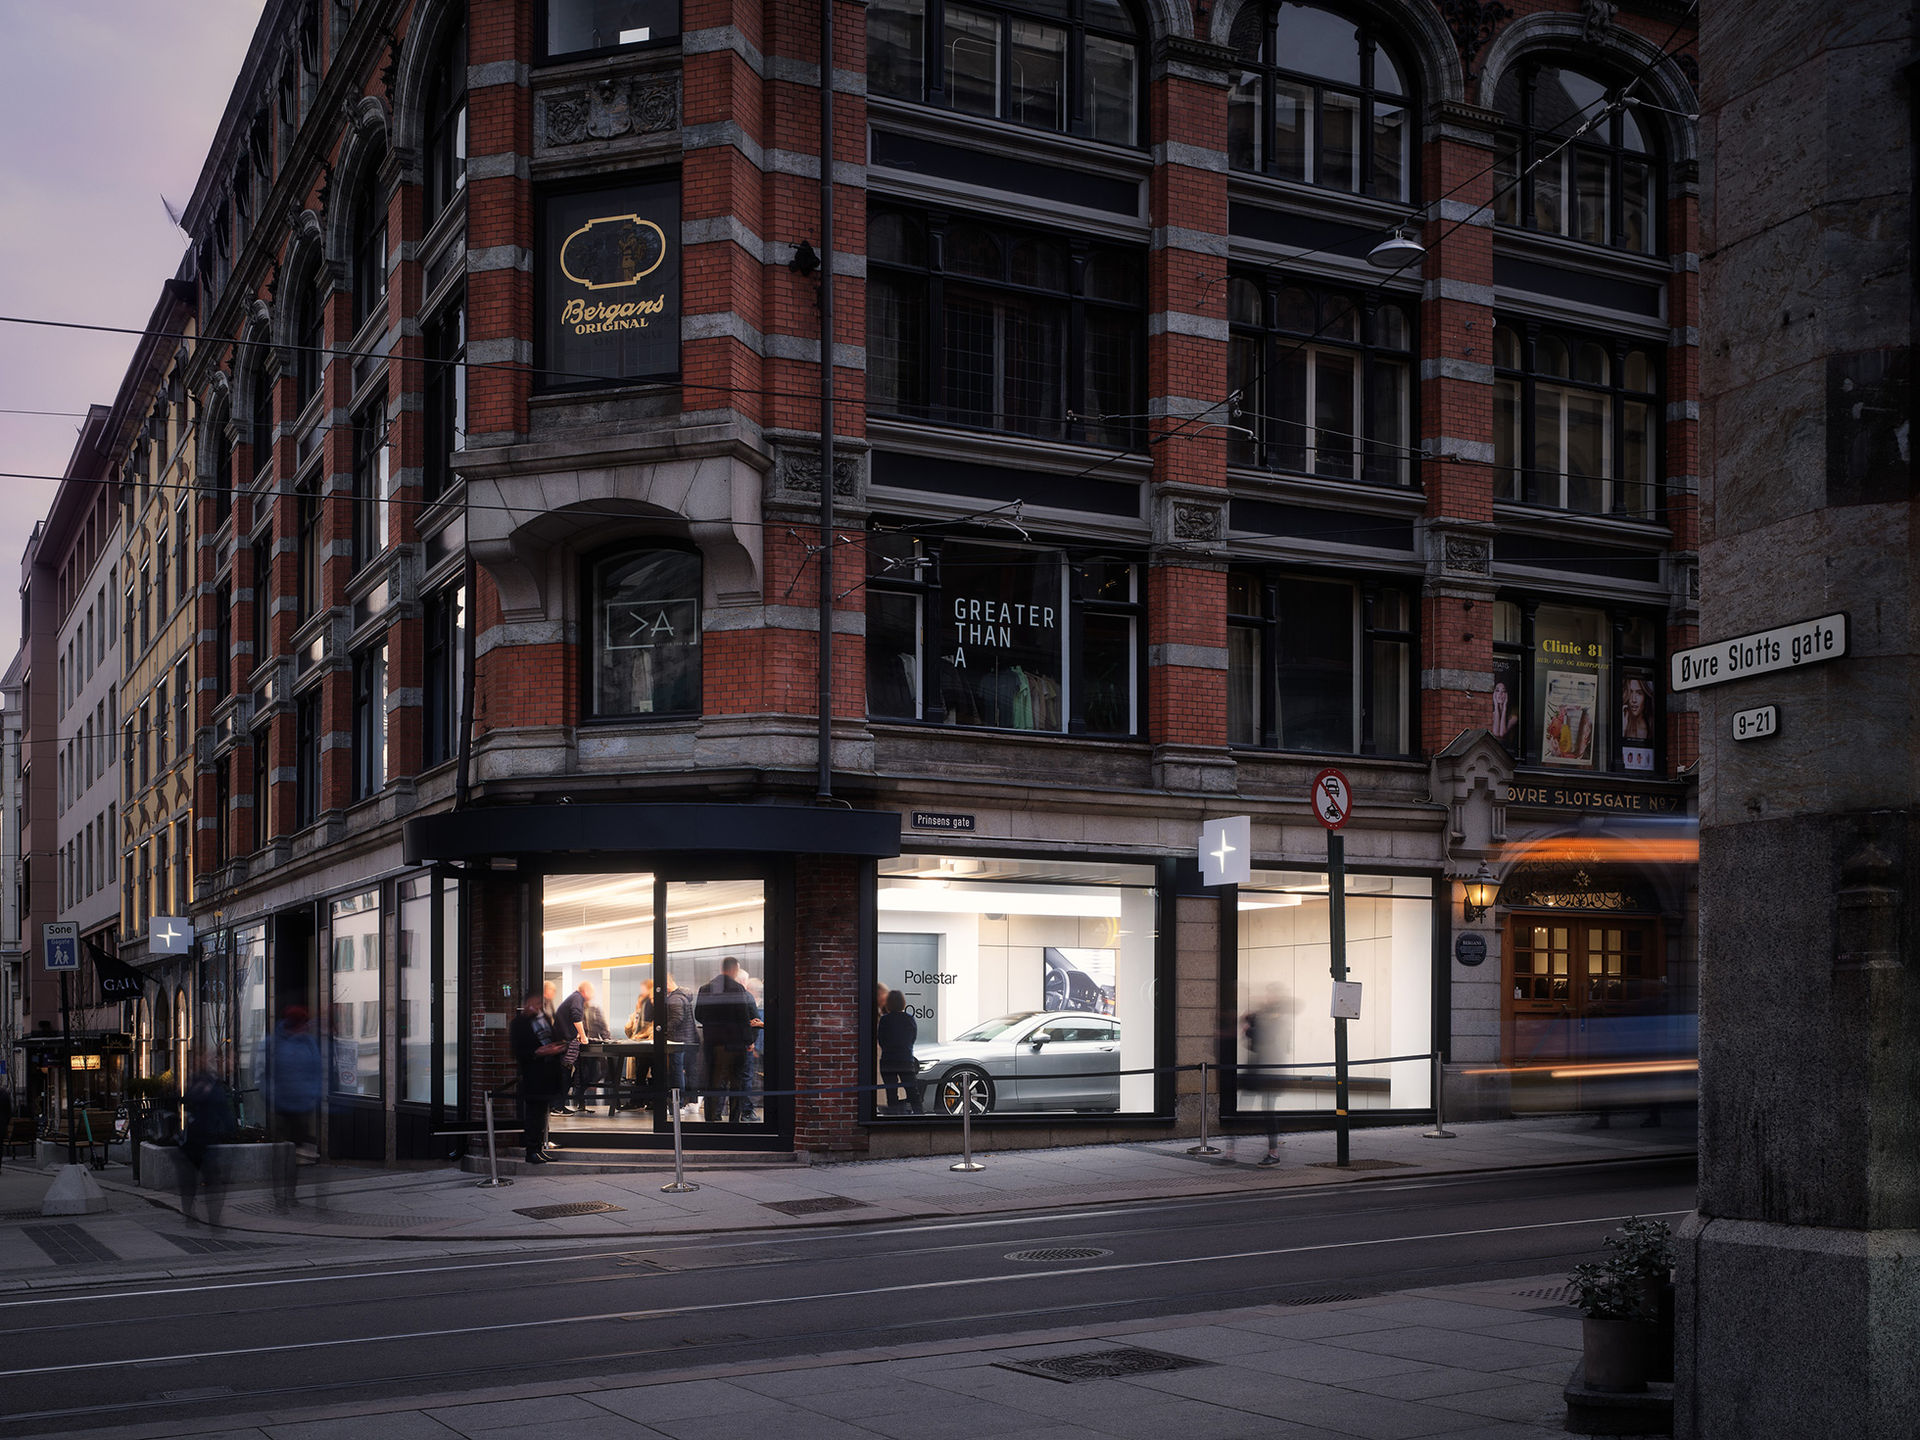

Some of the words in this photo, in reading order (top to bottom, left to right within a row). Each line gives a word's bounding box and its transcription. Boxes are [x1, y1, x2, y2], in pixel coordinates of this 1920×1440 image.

[561, 294, 664, 325] Bergans
[575, 317, 649, 335] ORIGINAL
[955, 597, 1055, 628] GREATER
[955, 621, 1011, 649] THAN
[954, 646, 967, 669] A
[1542, 639, 1582, 655] Clinic
[1587, 643, 1603, 657] 81
[1681, 655, 1718, 682] Øvre
[1729, 637, 1781, 671] Slotts
[1792, 625, 1833, 664] gate
[1739, 711, 1770, 735] 9-21
[1507, 786, 1548, 803] ØVRE
[1555, 790, 1641, 809] SLOTSGATE
[917, 814, 950, 826] Prinsens
[952, 817, 970, 829] gate
[49, 925, 72, 935] Sone
[905, 970, 958, 984] Polestar
[905, 1004, 935, 1019] Oslo
